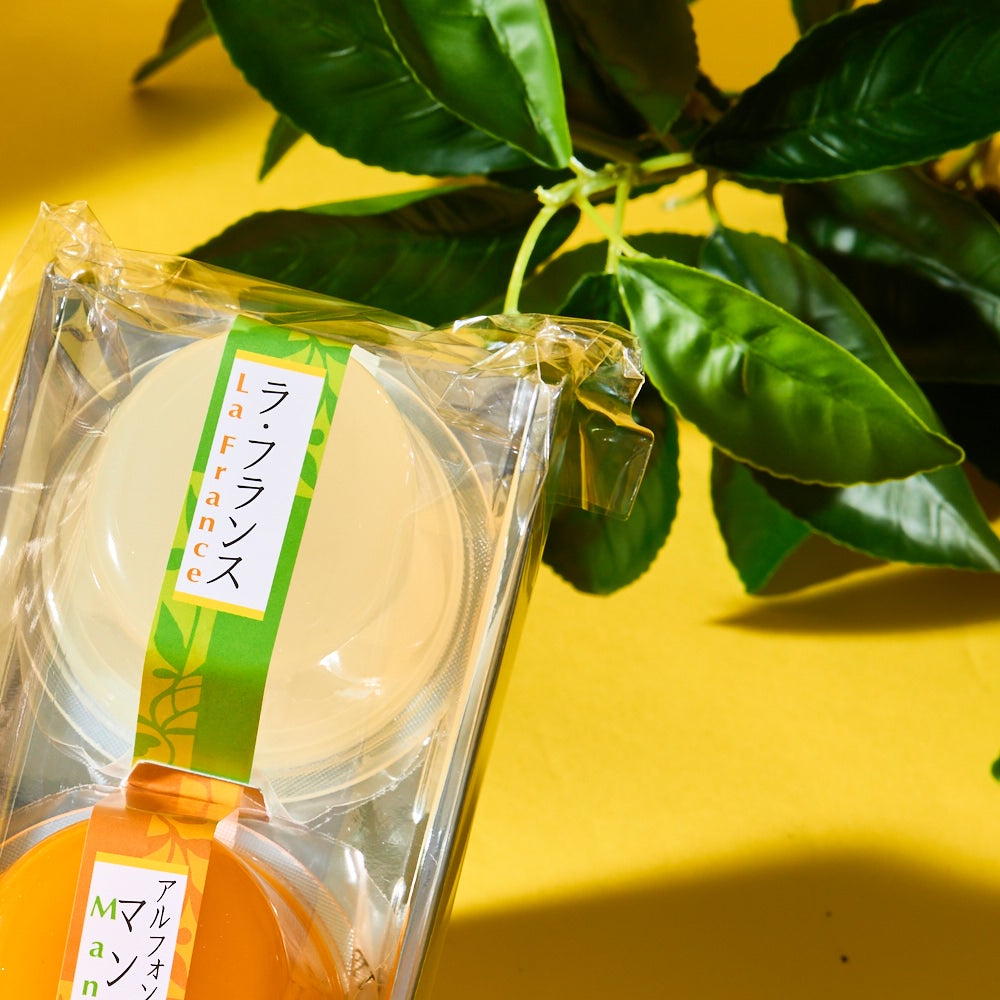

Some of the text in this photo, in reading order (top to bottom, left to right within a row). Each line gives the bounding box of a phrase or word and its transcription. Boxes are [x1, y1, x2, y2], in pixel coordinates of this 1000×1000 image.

[186, 372, 249, 583] La France
[206, 381, 289, 589] ラ・フランス
